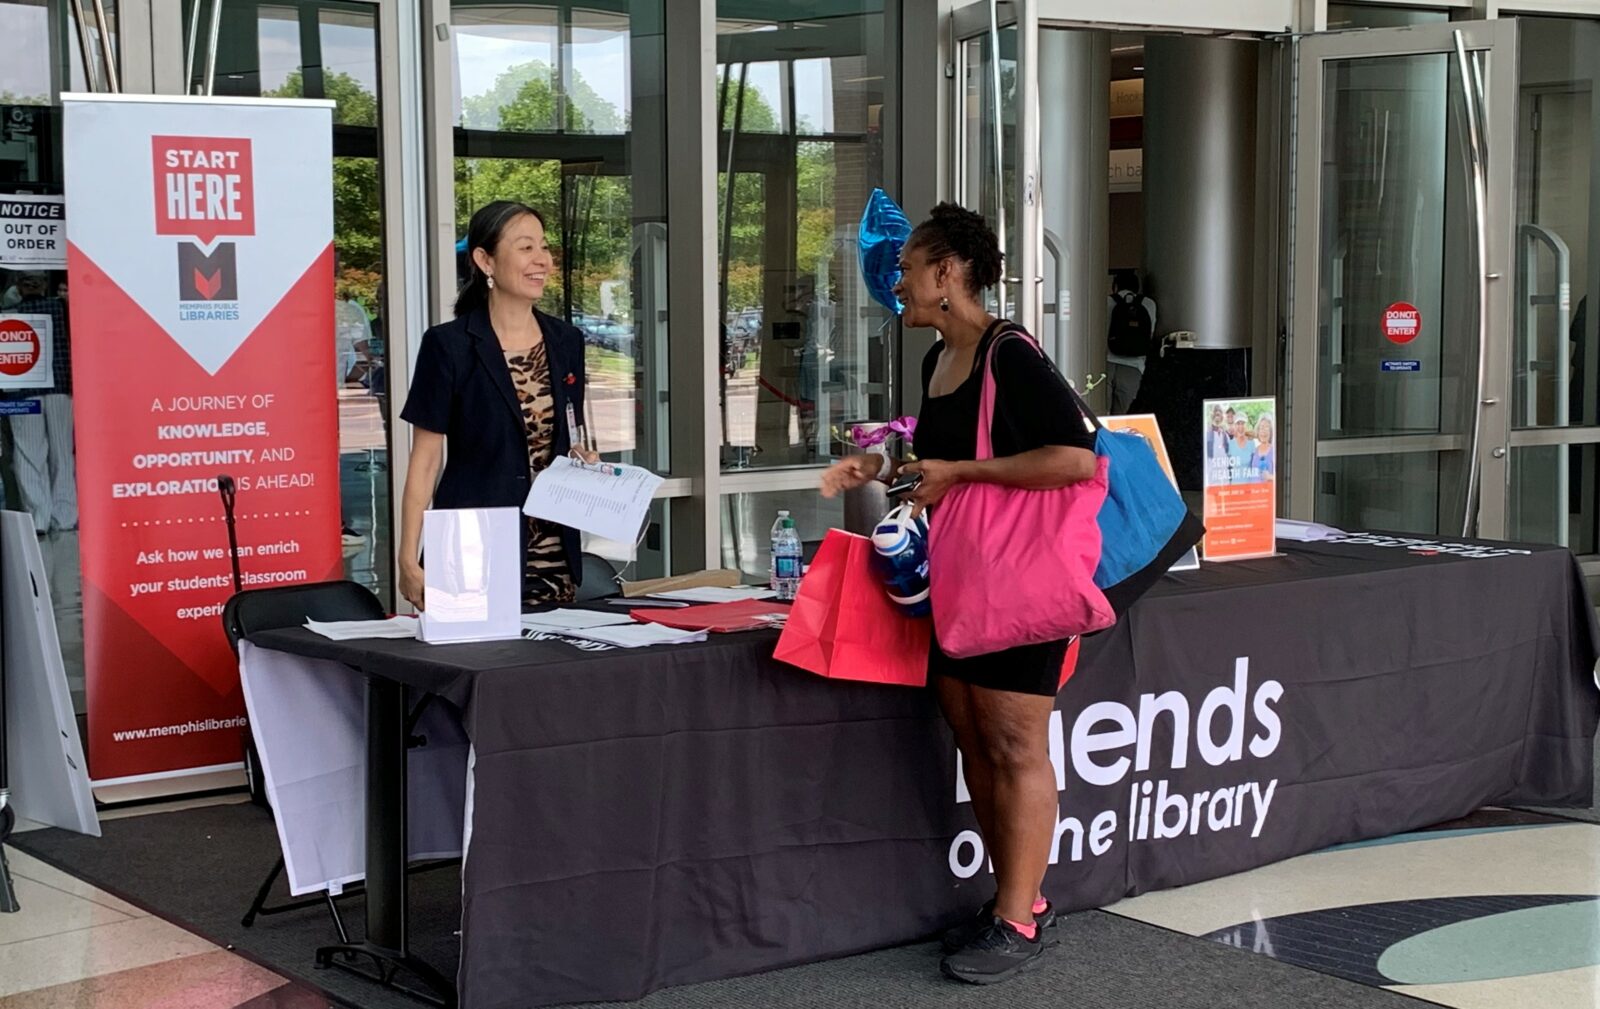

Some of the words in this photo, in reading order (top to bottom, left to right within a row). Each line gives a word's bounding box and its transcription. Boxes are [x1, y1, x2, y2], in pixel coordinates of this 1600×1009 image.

[165, 149, 240, 169] START
[166, 173, 242, 220] HERE
[1, 203, 60, 217] NOTICE
[4, 223, 33, 235] OUT
[38, 224, 58, 236] OF
[7, 238, 56, 250] ORDER
[179, 311, 239, 321] LIBRARIES
[1386, 311, 1399, 319] DO
[1400, 311, 1417, 319] NOT
[0, 331, 9, 341] O
[10, 330, 33, 341] NOT
[151, 398, 163, 412] A
[168, 396, 247, 412] JOURNEY
[251, 394, 275, 409] OF
[158, 421, 270, 440] KNOWLEDGE,
[133, 449, 256, 469] OPPORTUNITY,
[260, 447, 295, 463] AND
[1211, 456, 1241, 468] SENIOR
[1211, 468, 1240, 481] HEALTH
[1242, 467, 1260, 479] FAIR
[112, 478, 220, 498] EXPLORATIO
[237, 476, 251, 491] IS
[255, 473, 315, 490] AHEAD!
[136, 551, 164, 565] Ask
[168, 549, 198, 563] how
[203, 549, 224, 561] we
[257, 540, 300, 556] enrich
[130, 580, 162, 597] your
[167, 573, 233, 592] students'
[113, 715, 247, 742] www.memphislibrarie
[948, 829, 994, 879] o
[1048, 802, 1118, 865] he
[1128, 779, 1279, 842] library
